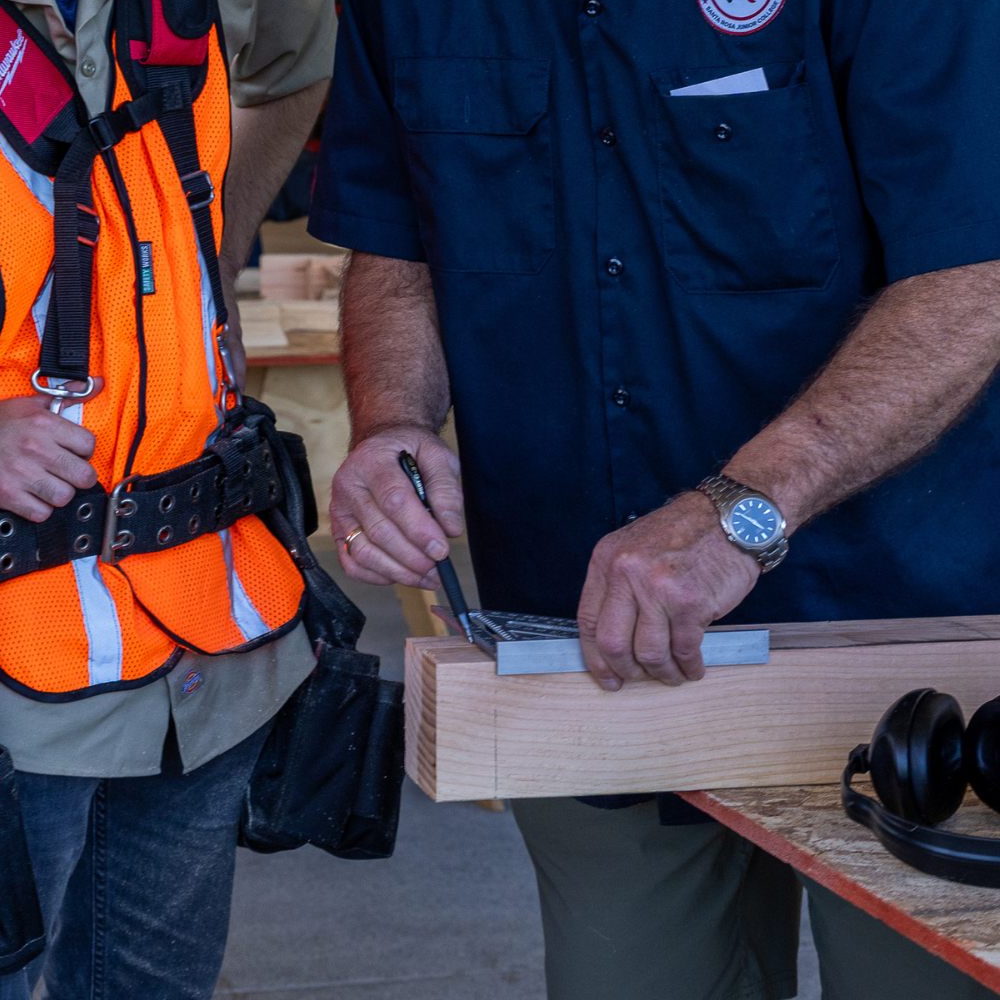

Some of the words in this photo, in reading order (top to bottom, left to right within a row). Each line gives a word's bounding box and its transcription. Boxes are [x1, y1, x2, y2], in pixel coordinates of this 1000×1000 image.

[706, 6, 720, 23] SANTA
[720, 20, 735, 29] ROSA
[736, 21, 758, 30] JUNIOR
[757, 1, 778, 24] COLLEGE
